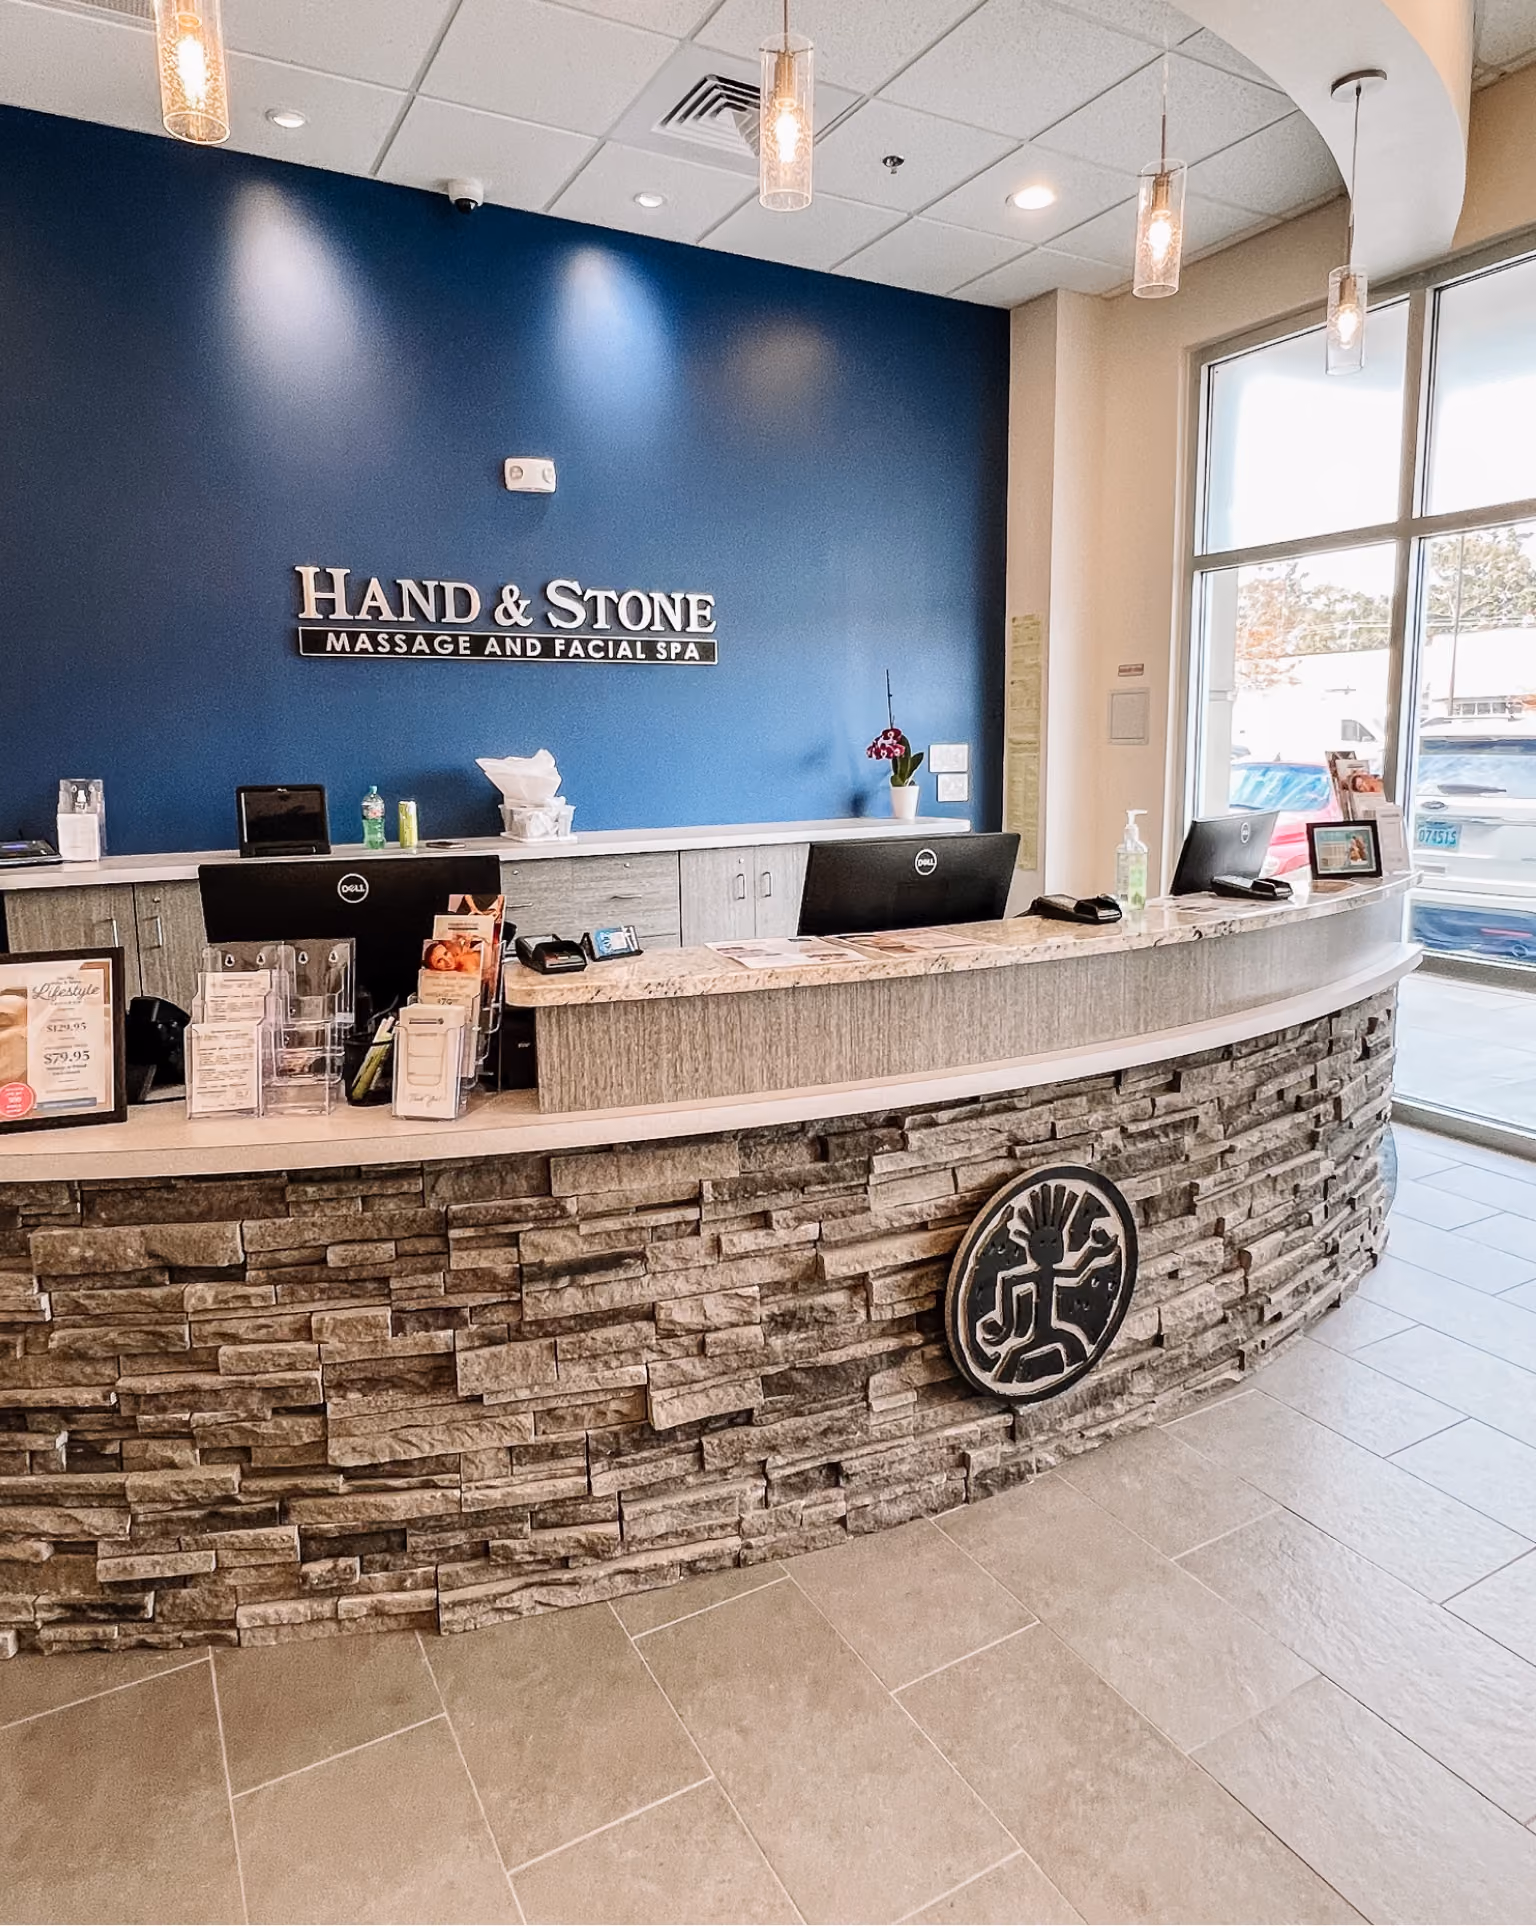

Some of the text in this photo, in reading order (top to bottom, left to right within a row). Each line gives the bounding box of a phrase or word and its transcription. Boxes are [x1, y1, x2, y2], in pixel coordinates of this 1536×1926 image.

[294, 566, 717, 633] HAND & STONE
[326, 632, 700, 661] MASSAGE AND FACIAL SPA
[341, 884, 366, 893] DELL
[32, 983, 100, 1001] Lifestyle
[46, 1022, 87, 1032] $129.95
[43, 1050, 90, 1065] $79.95
